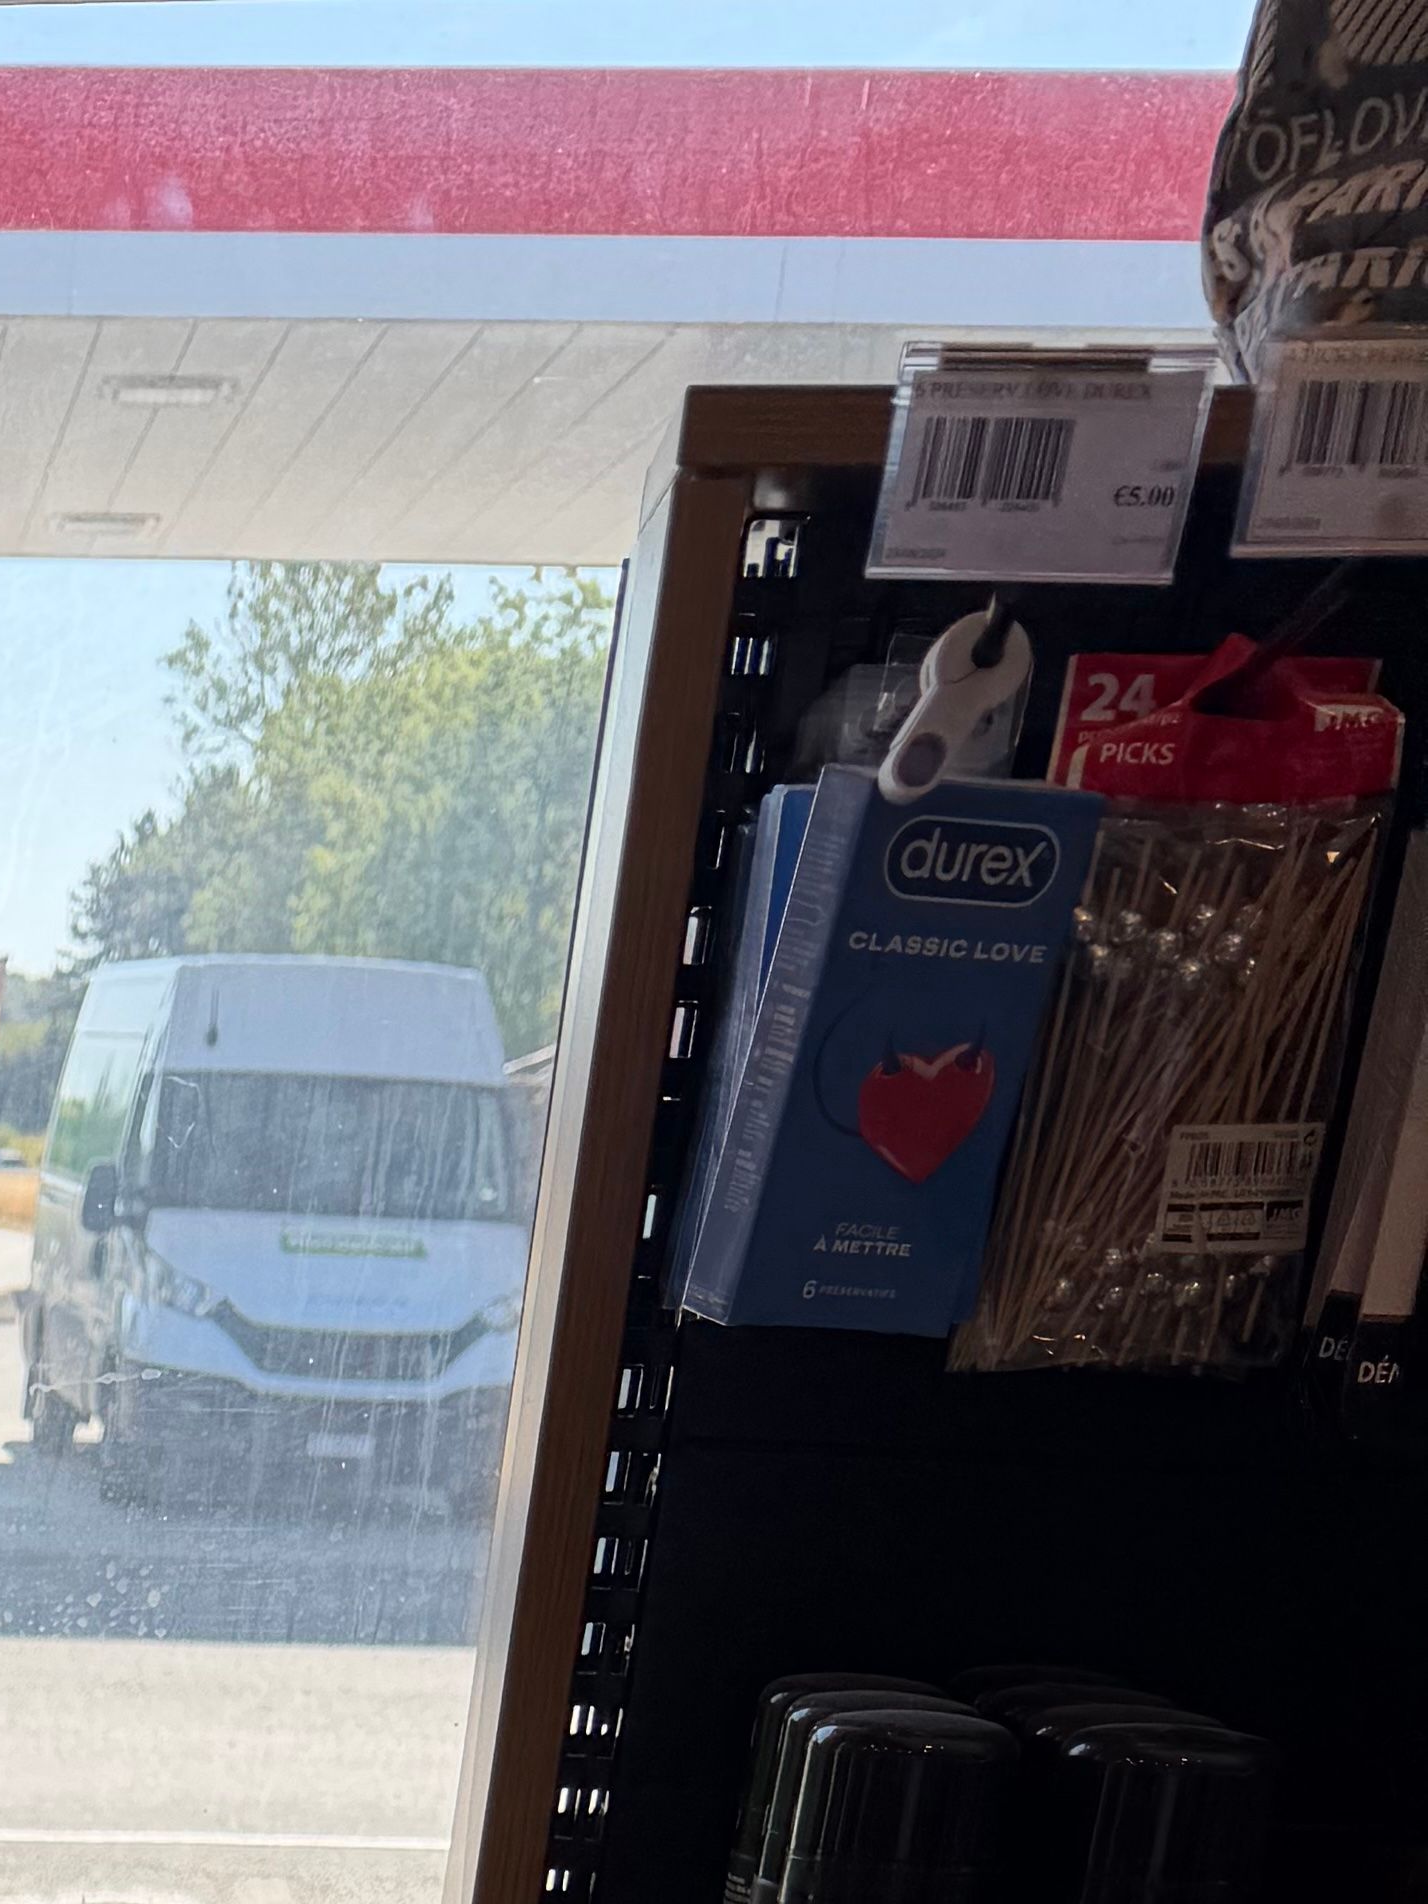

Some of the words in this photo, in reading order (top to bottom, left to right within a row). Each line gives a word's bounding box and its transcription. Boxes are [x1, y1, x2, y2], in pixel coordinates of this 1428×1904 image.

[1113, 485, 1175, 508] €5.00
[1080, 672, 1157, 723] 24
[1100, 741, 1176, 766] PICKS
[899, 826, 1049, 889] durex
[848, 930, 969, 961] CLASSIC
[973, 940, 1047, 965] LOVE
[835, 1222, 902, 1240] FACILE
[830, 1239, 913, 1258] METTRE
[801, 1280, 818, 1300] 6
